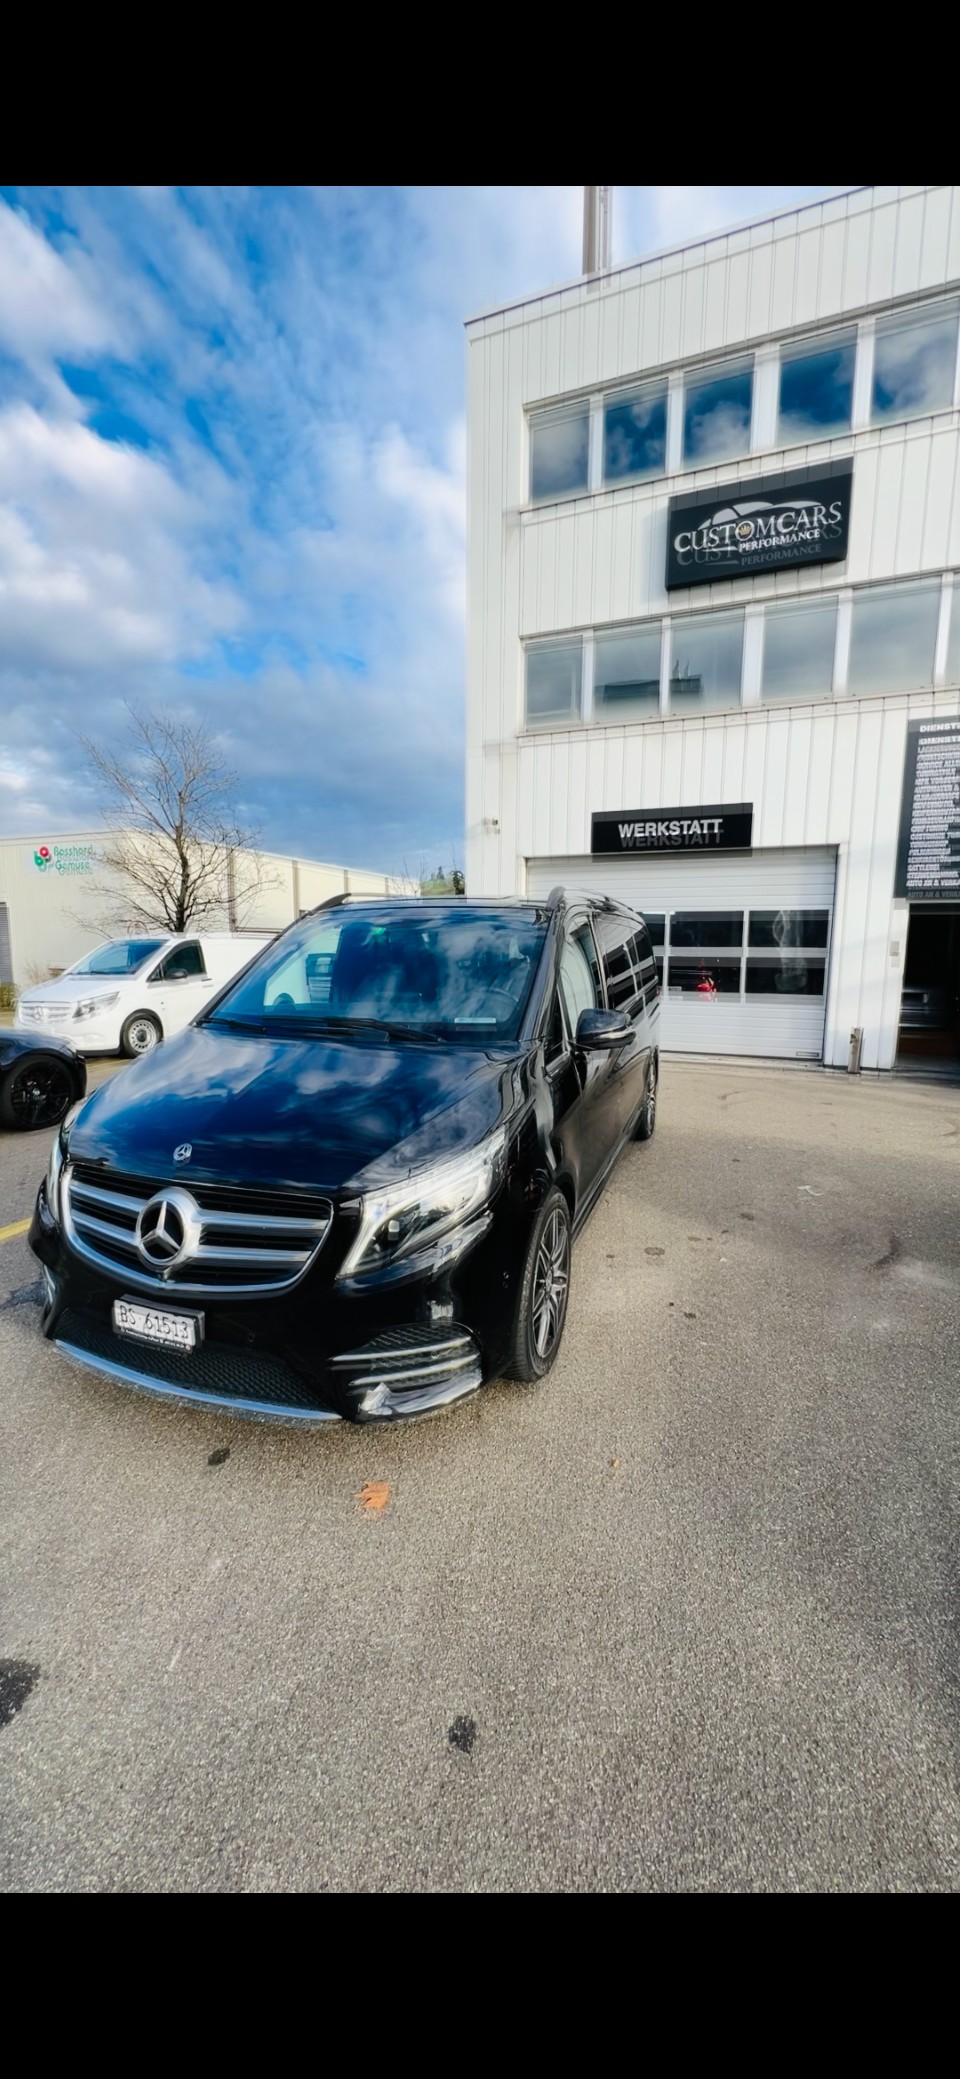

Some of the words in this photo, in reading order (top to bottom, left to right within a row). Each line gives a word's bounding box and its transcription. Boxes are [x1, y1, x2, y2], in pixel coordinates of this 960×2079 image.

[674, 501, 842, 552] CUSTOMCARS
[739, 528, 821, 552] PERFORMANCE
[618, 819, 723, 838] WERKSTATT
[53, 844, 93, 857] Bosshard
[119, 1304, 136, 1325] BS
[145, 1313, 189, 1339] 61513
